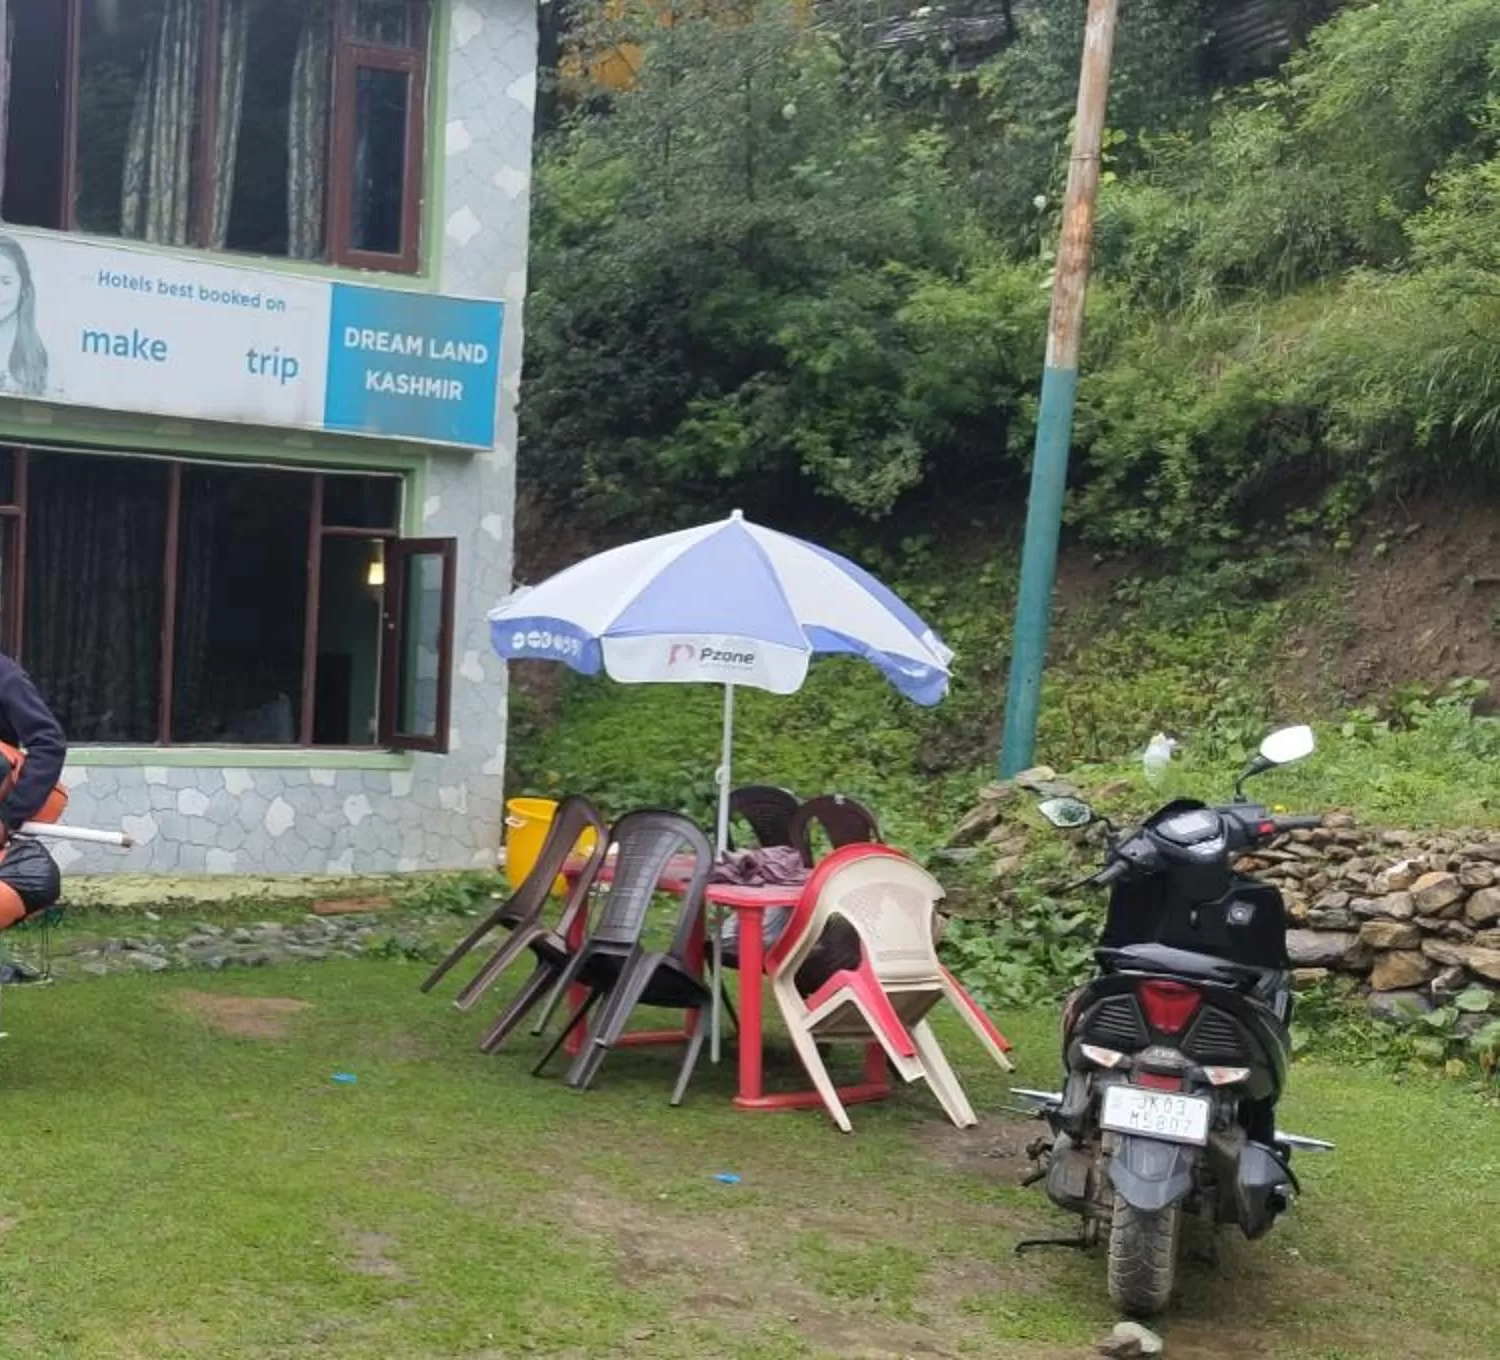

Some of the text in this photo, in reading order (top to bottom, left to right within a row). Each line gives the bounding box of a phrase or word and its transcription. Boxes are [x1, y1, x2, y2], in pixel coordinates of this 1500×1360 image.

[97, 269, 286, 312] Hotels best booked on
[81, 327, 299, 385] make trip
[343, 325, 489, 365] DREAM LAND
[365, 368, 464, 401] KASHMIR
[699, 647, 755, 665] Pzone
[1138, 1095, 1186, 1116] JK03
